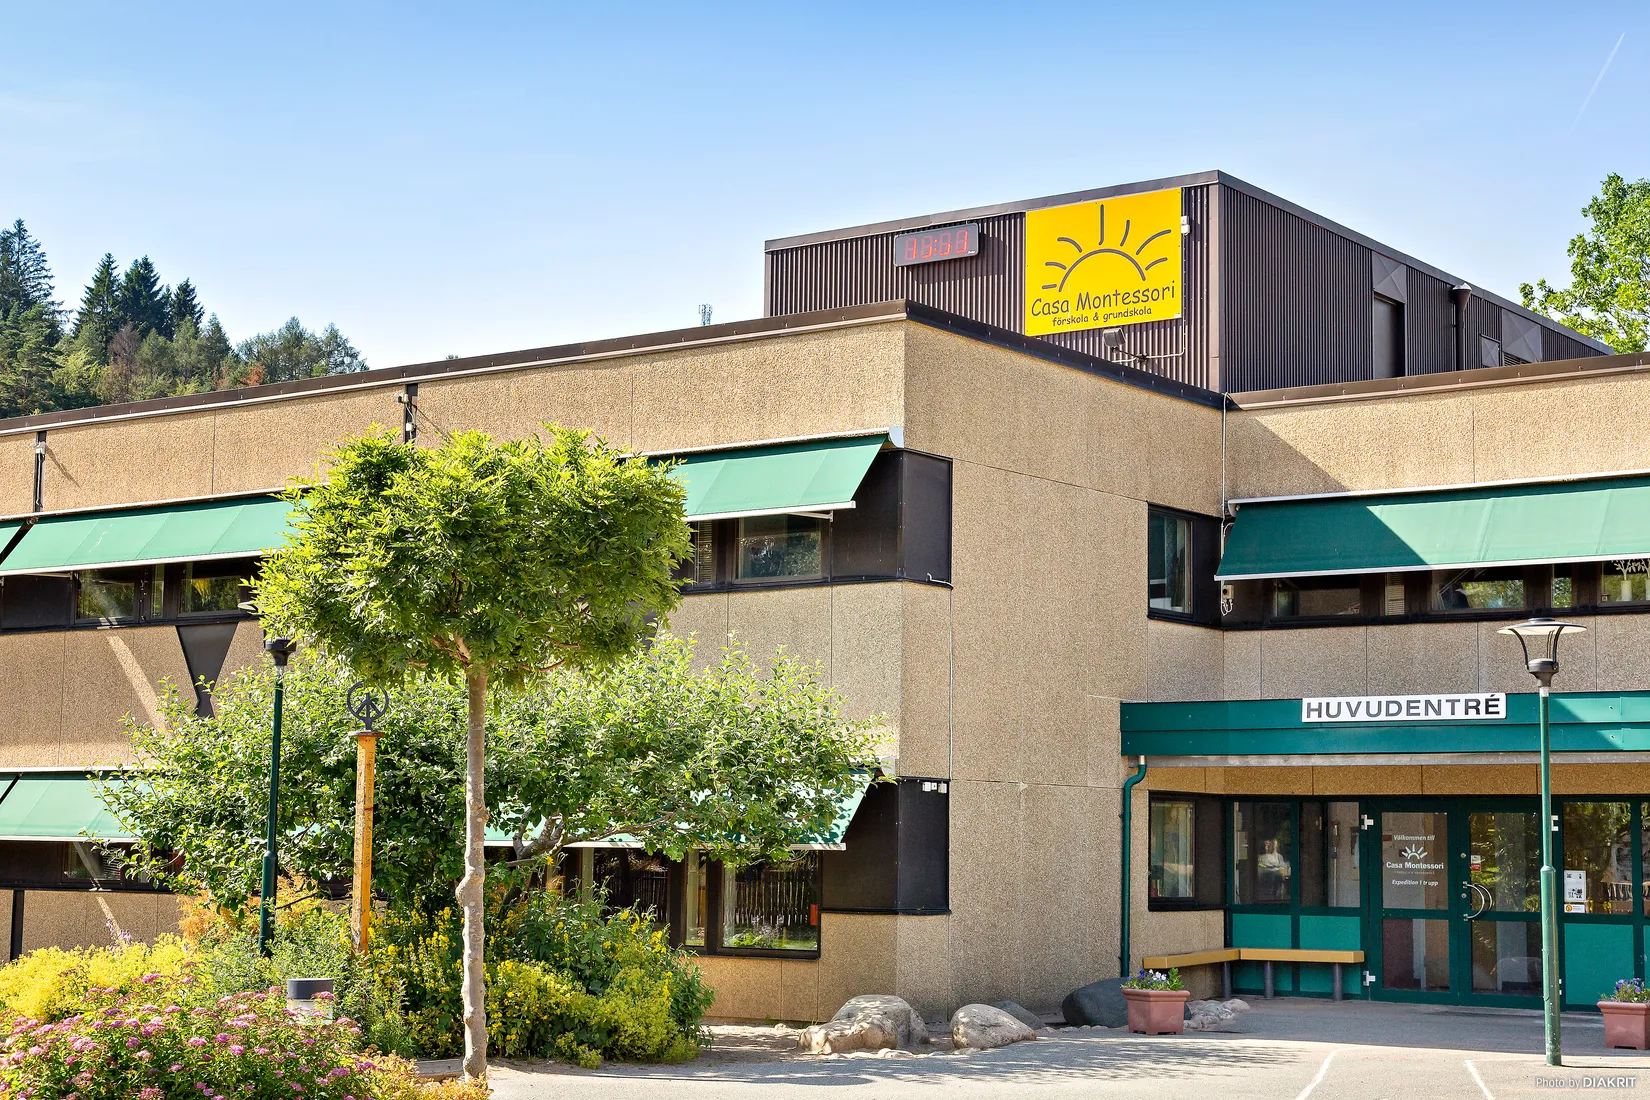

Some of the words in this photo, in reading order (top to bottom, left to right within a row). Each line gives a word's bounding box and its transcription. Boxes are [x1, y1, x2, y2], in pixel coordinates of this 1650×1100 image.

[1031, 298, 1070, 317] Casa
[1075, 280, 1175, 312] Montessori
[1052, 315, 1089, 327] förskola
[1092, 312, 1100, 321] &
[1103, 306, 1152, 323] grundskola
[1306, 694, 1501, 719] HUVUDENTRÉ
[1386, 861, 1403, 869] Casa
